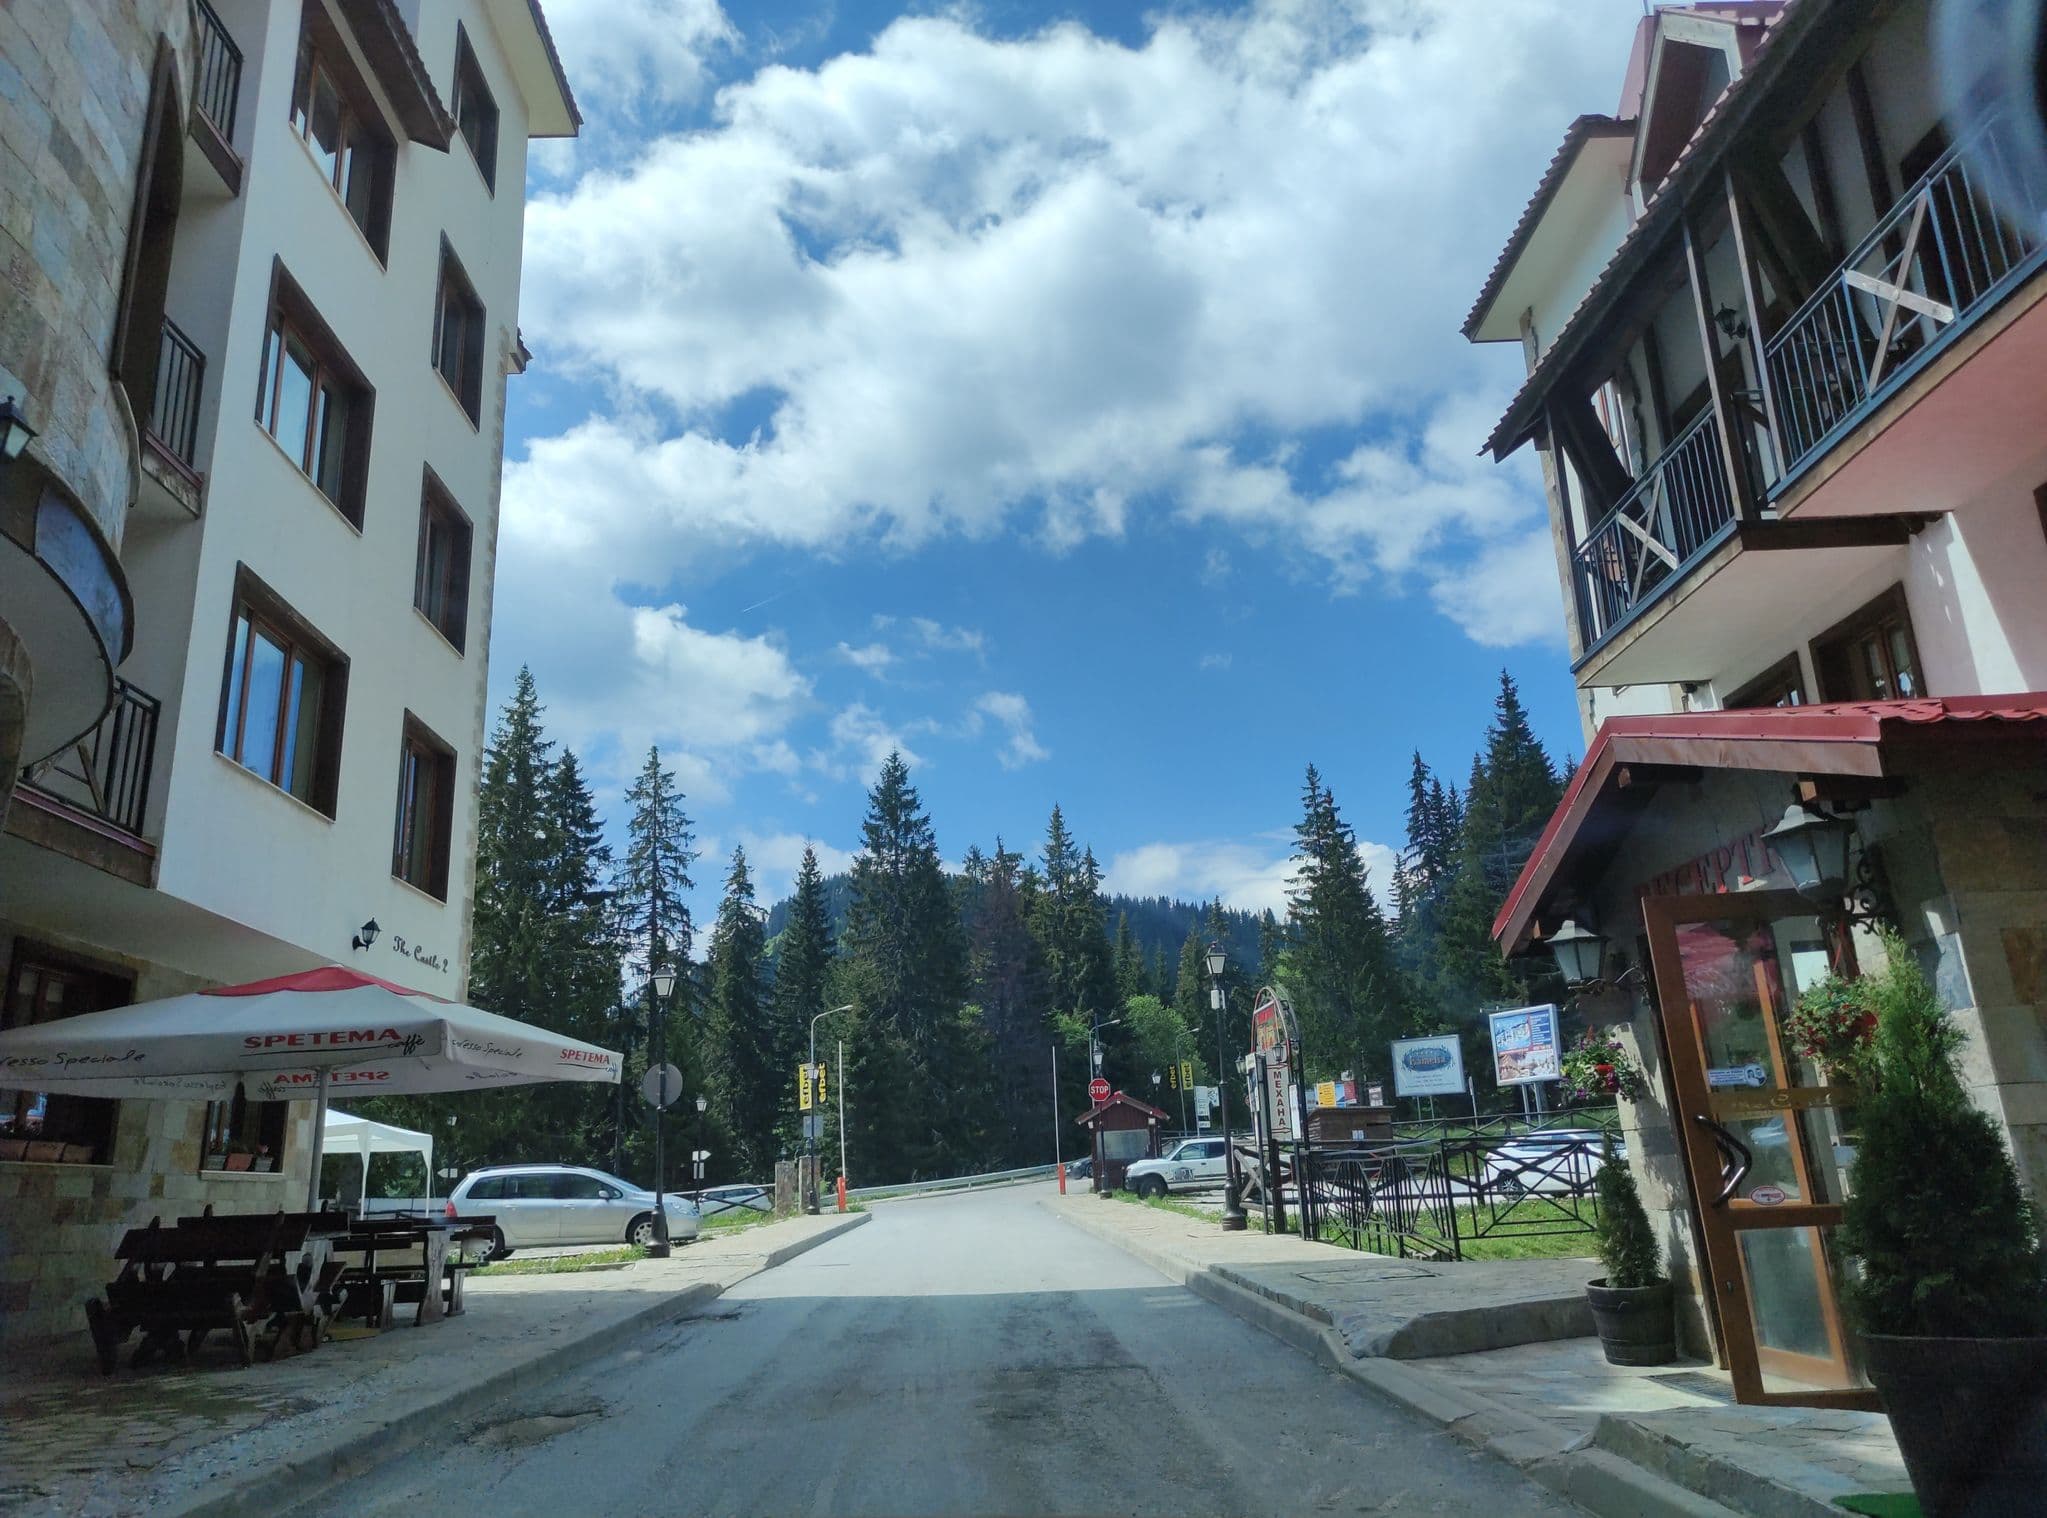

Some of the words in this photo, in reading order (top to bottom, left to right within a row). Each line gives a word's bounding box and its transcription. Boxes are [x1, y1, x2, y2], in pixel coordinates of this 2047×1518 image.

[393, 936, 411, 956] The
[442, 958, 449, 974] 2
[244, 1028, 401, 1049] SPETEMA
[53, 1050, 146, 1070] Speciale
[560, 1048, 609, 1065] SPETEMA
[1090, 1085, 1109, 1095] STOP
